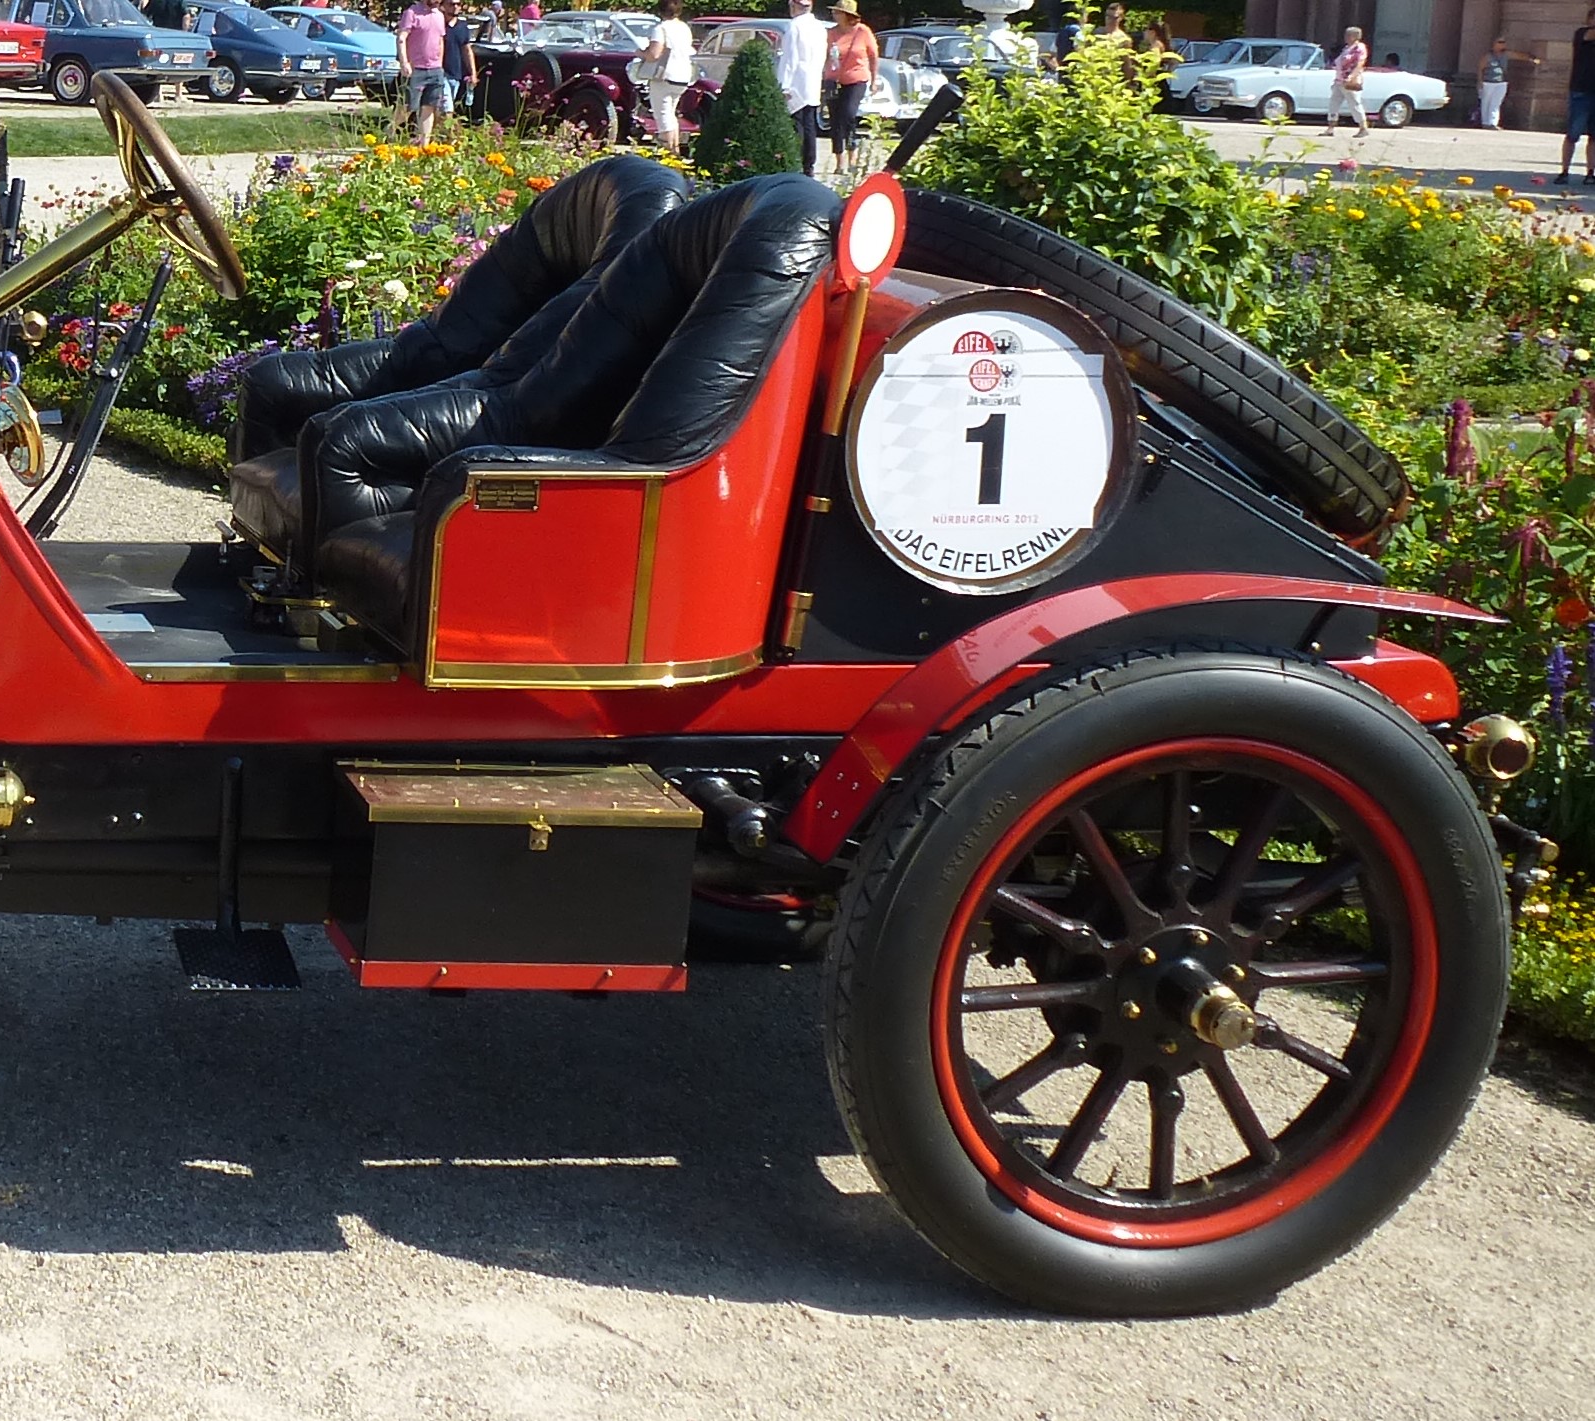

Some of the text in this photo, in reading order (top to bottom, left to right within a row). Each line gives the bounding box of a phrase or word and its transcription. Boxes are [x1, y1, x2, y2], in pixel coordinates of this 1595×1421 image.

[957, 333, 989, 352] EIFEL
[972, 361, 997, 374] EIFEL
[965, 413, 1007, 505] 1
[932, 513, 1040, 524] NÜRBURGRING 2012
[889, 529, 938, 561] DAC
